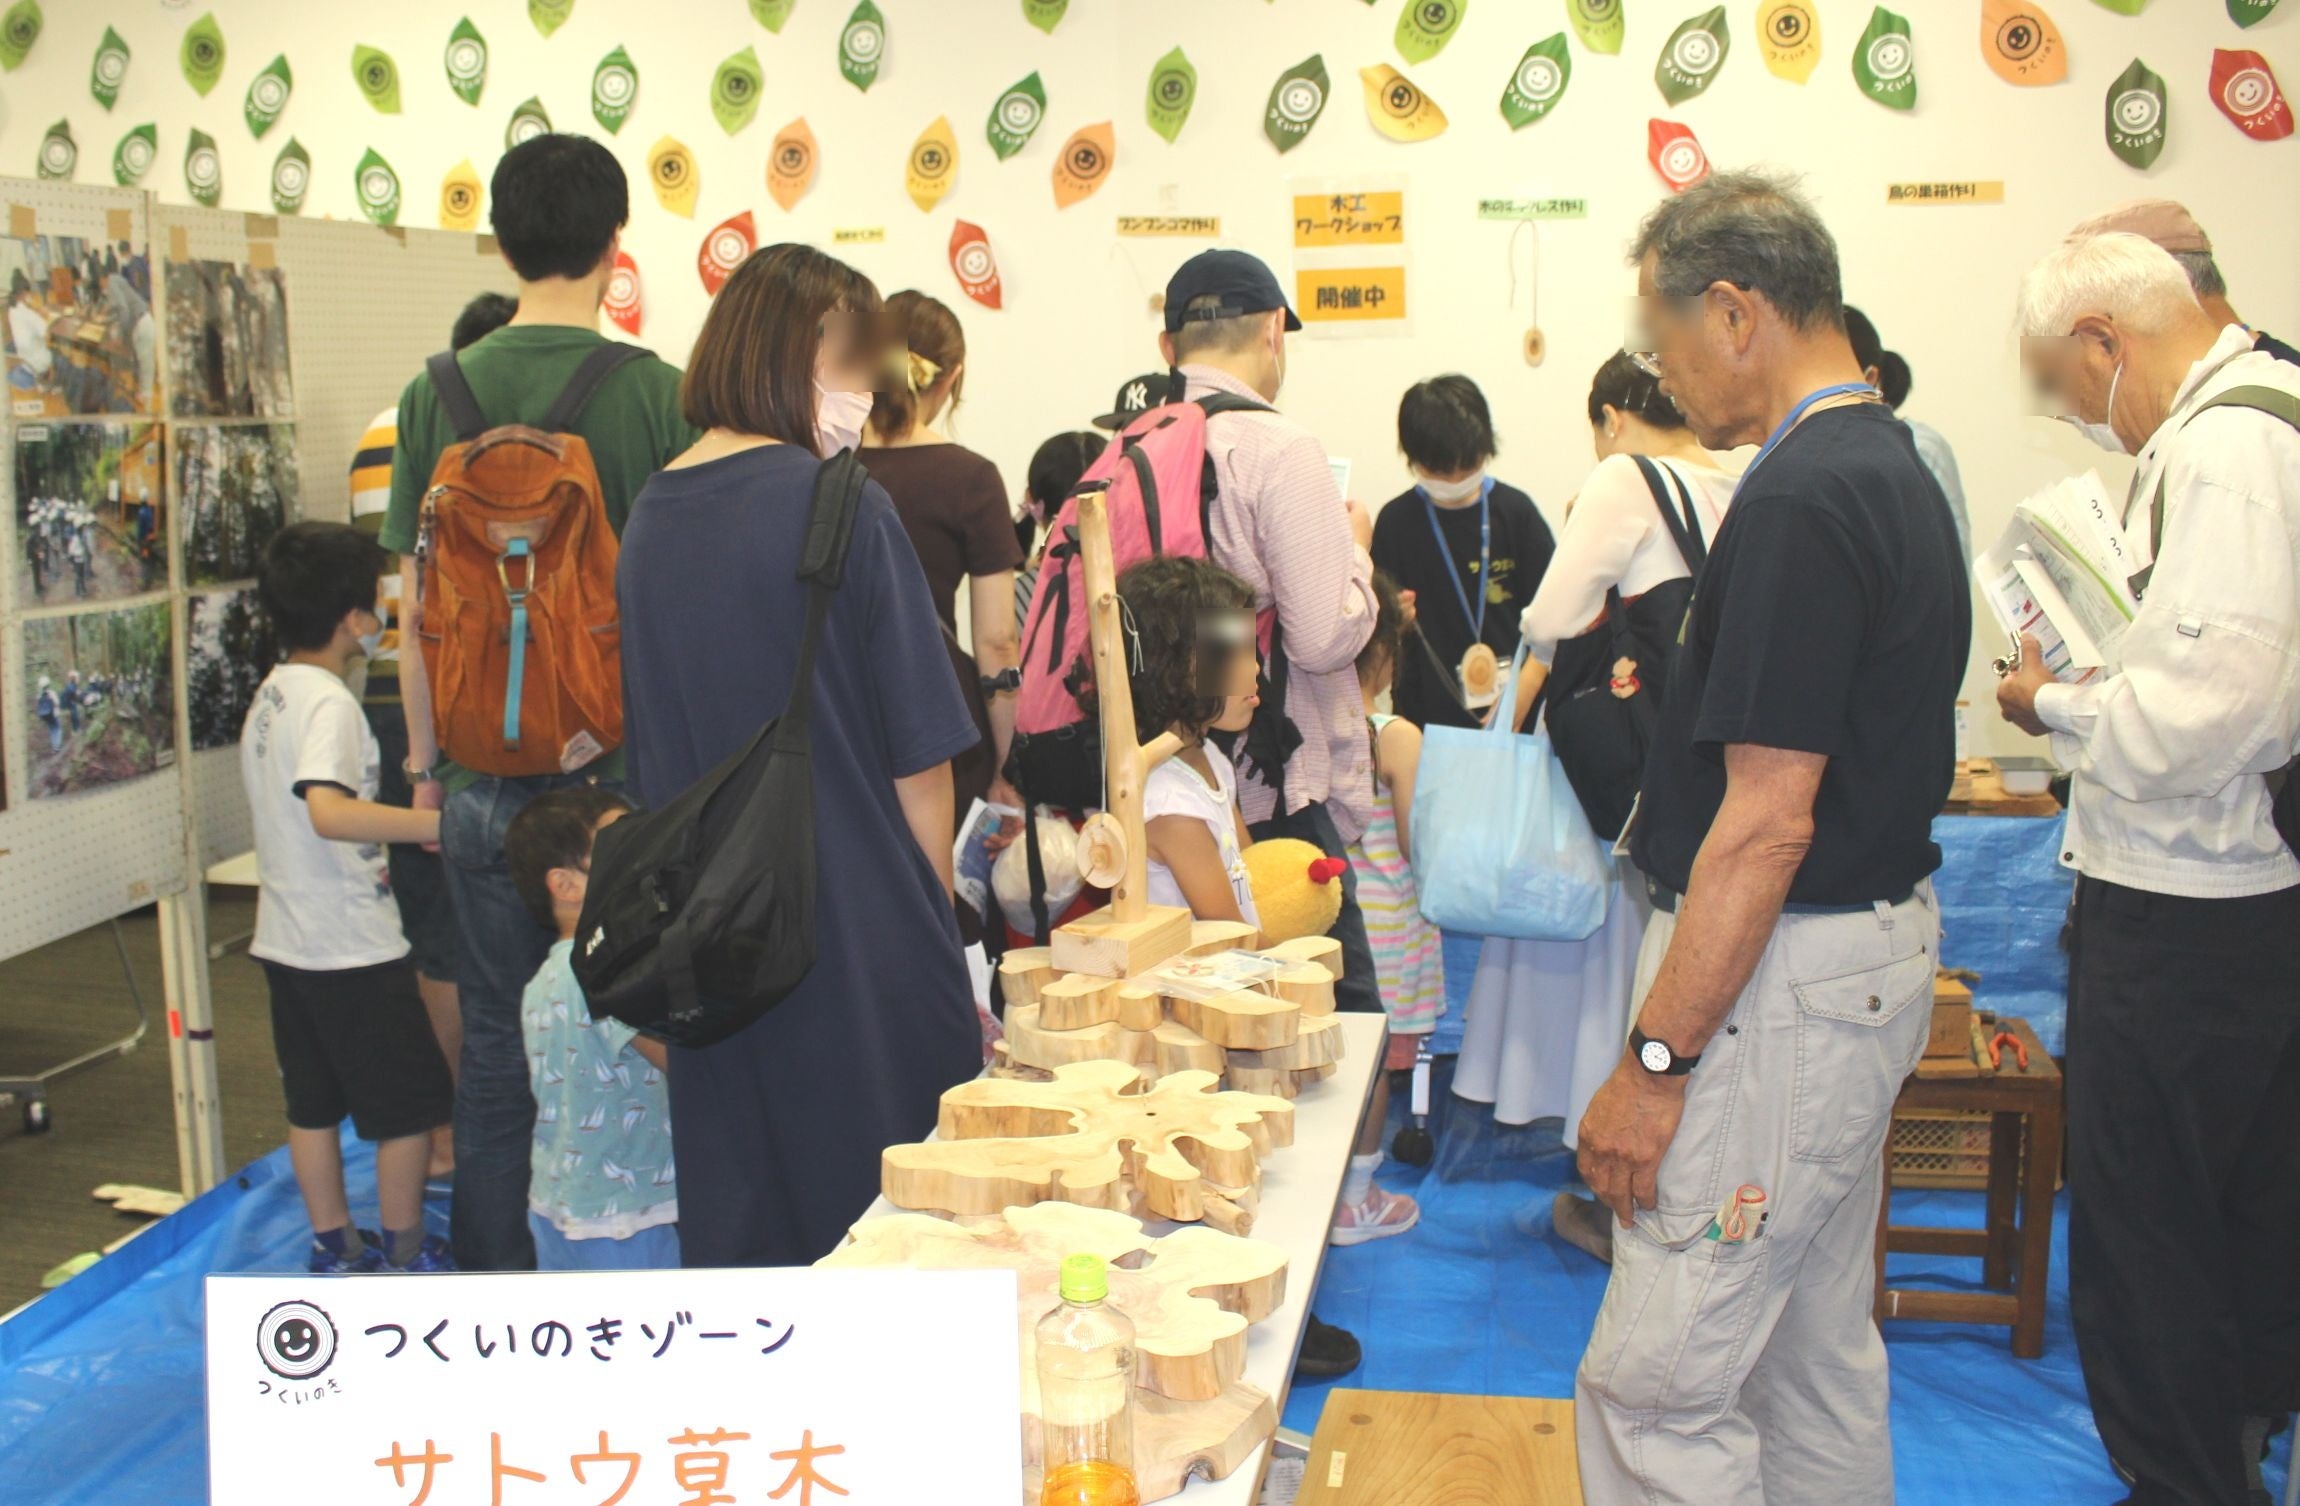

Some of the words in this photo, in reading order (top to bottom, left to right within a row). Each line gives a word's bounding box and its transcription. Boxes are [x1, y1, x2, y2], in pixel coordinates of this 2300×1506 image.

[1663, 58, 1702, 88] つくいのき
[1873, 73, 1912, 93] つくいの
[2114, 129, 2161, 148] つくいのき
[1330, 194, 1366, 212] 木工
[1888, 184, 1975, 200] 鳥の巣箱作り
[1316, 285, 1385, 310] 開催中
[1124, 382, 1147, 410] NY
[364, 1312, 795, 1362] つくいのきゾーン
[258, 1379, 342, 1405] つくいのき
[374, 1427, 849, 1506] サトウ草木
